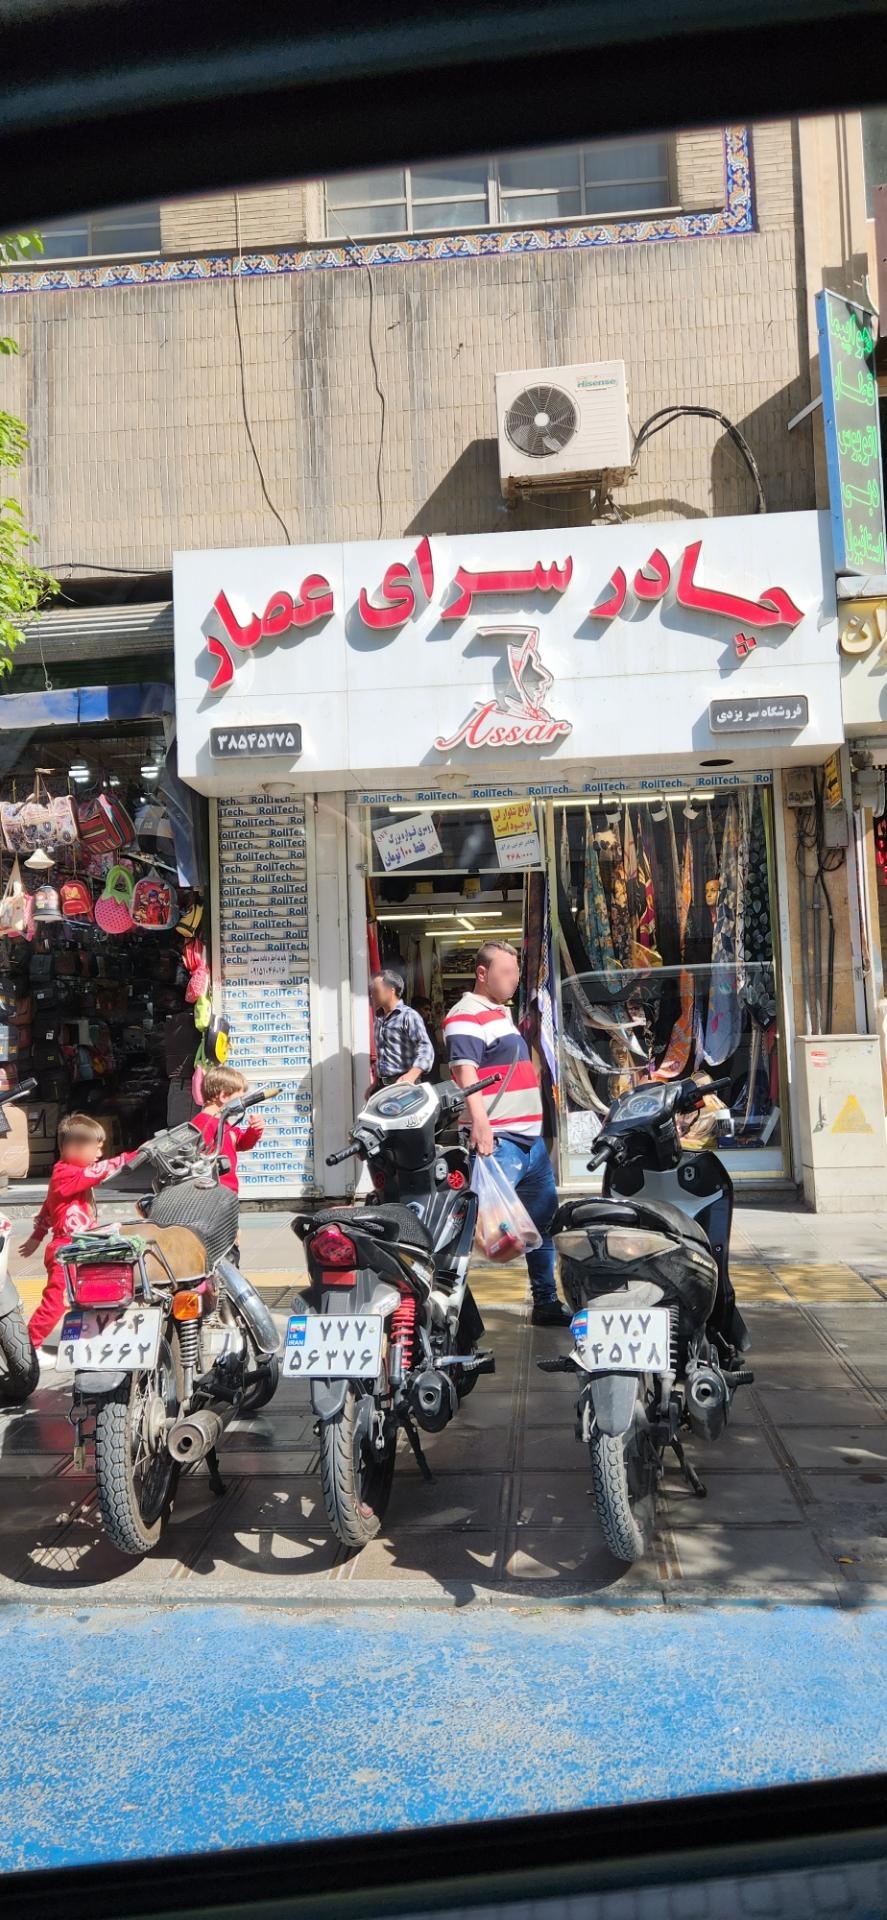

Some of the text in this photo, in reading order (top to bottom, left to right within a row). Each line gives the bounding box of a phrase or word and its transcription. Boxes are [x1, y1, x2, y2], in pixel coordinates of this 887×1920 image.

[834, 361, 874, 406] قطار
[838, 426, 878, 466] اتوبوس
[846, 518, 884, 566] استانبول
[207, 535, 805, 692] چادر سرای عصار
[716, 704, 802, 723] فروشگاه سر یزدی
[434, 700, 573, 751] Assar
[218, 732, 294, 750] ۳۸۵۴۵۲۷۵
[363, 775, 740, 804] RollTech RollTech RollTech RollTech RollTech RollTech RollTech
[259, 806, 298, 814] RollTech
[236, 818, 275, 828] RollTech
[497, 822, 509, 832] است
[221, 828, 305, 839] ollTech RollTe
[220, 841, 254, 850] ollTech
[413, 840, 426, 853] فقط
[236, 852, 275, 861] RollTech
[385, 849, 400, 867] تومان
[221, 862, 295, 873] Tech RollTech
[252, 873, 291, 883] RollTech
[235, 907, 307, 918] RollTech Roll
[253, 920, 291, 929] RollTech
[231, 930, 308, 941] RollTech RollT
[267, 940, 306, 950] RollTech
[224, 956, 242, 964] Tech
[263, 989, 303, 997] RollTech
[241, 1000, 280, 1009] RollTech
[247, 1012, 287, 1021] RollTech
[252, 1022, 291, 1031] RollTech
[271, 1034, 310, 1042] RollTech
[265, 1045, 304, 1054] RollTech
[228, 1059, 267, 1067] RollTech
[279, 1127, 313, 1135] RollTec
[253, 1151, 292, 1159] RollTech
[263, 1162, 304, 1170] RollTech
[245, 1175, 285, 1183] RollTech
[602, 1313, 651, 1335] ۷۷۷
[320, 1321, 366, 1341] ۷۷۷
[64, 1342, 151, 1364] ۹۱۶۶۲
[289, 1349, 373, 1370] ۵۶۳۷۶
